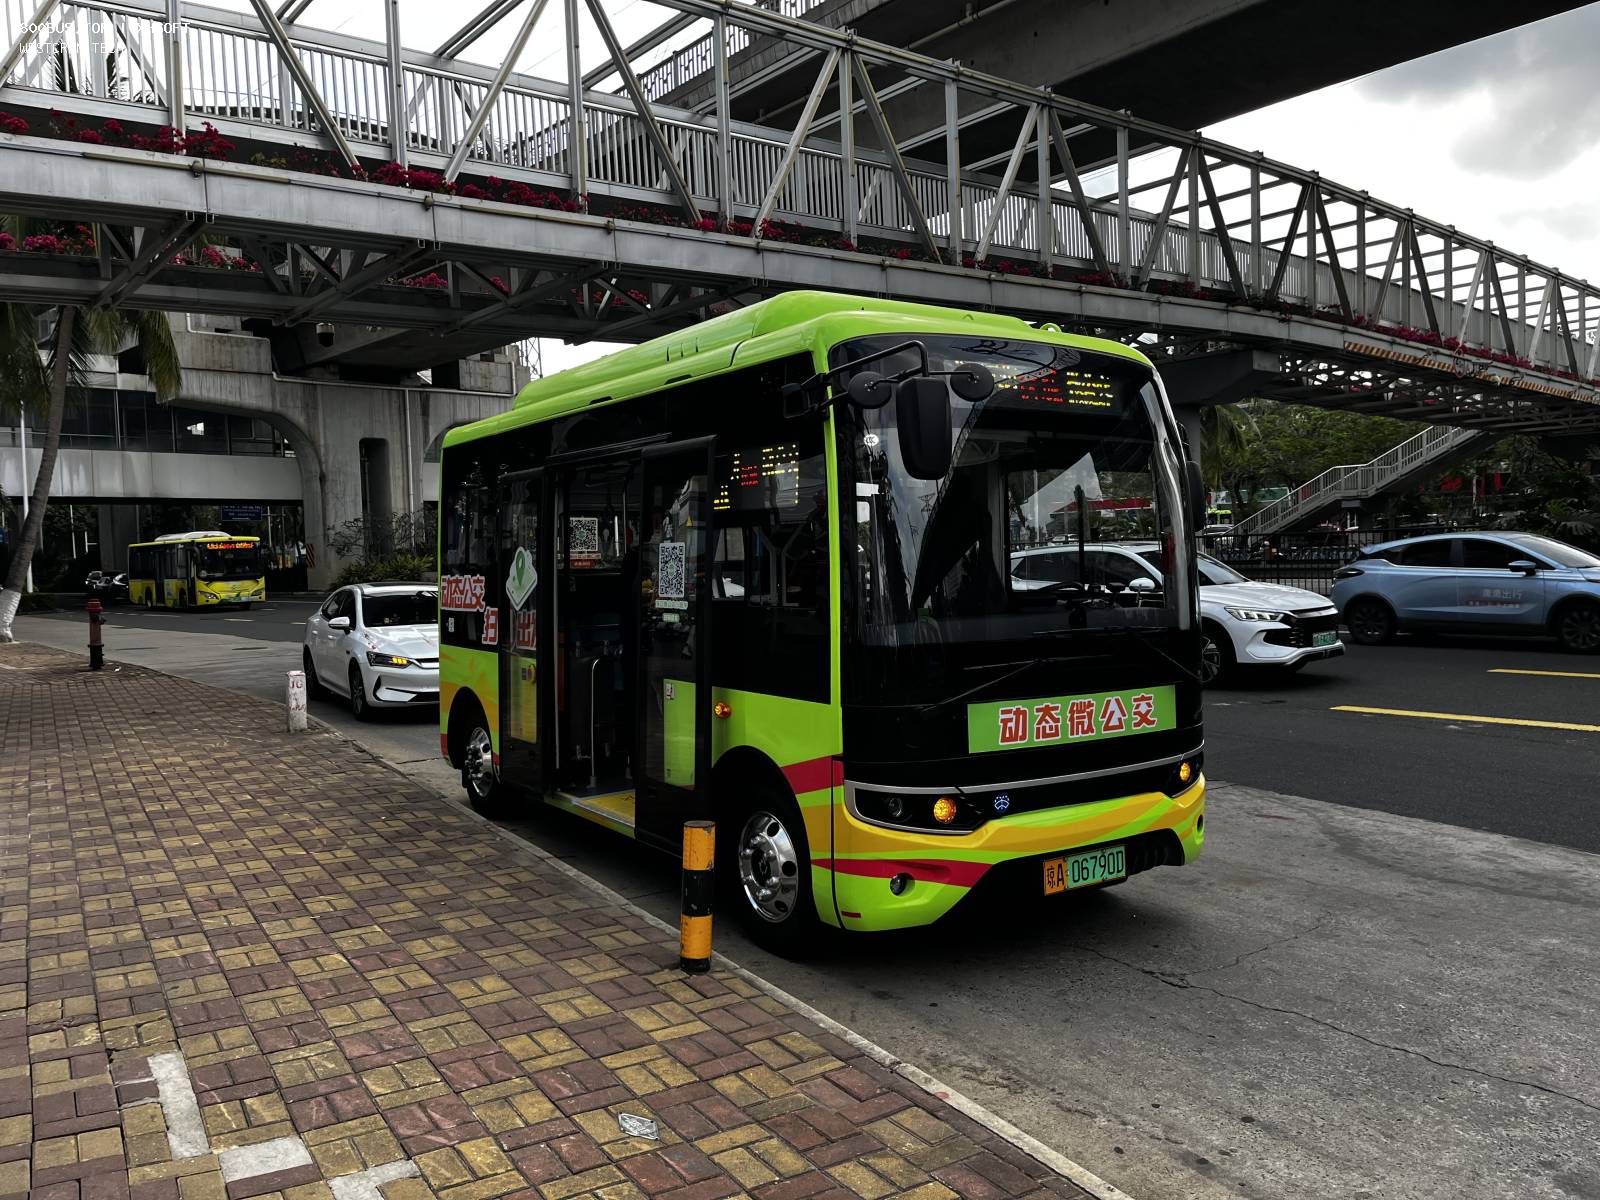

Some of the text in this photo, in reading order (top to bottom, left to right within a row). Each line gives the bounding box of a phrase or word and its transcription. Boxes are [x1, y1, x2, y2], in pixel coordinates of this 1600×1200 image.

[441, 574, 485, 612] 动态公交
[999, 693, 1157, 744] 动态微公交
